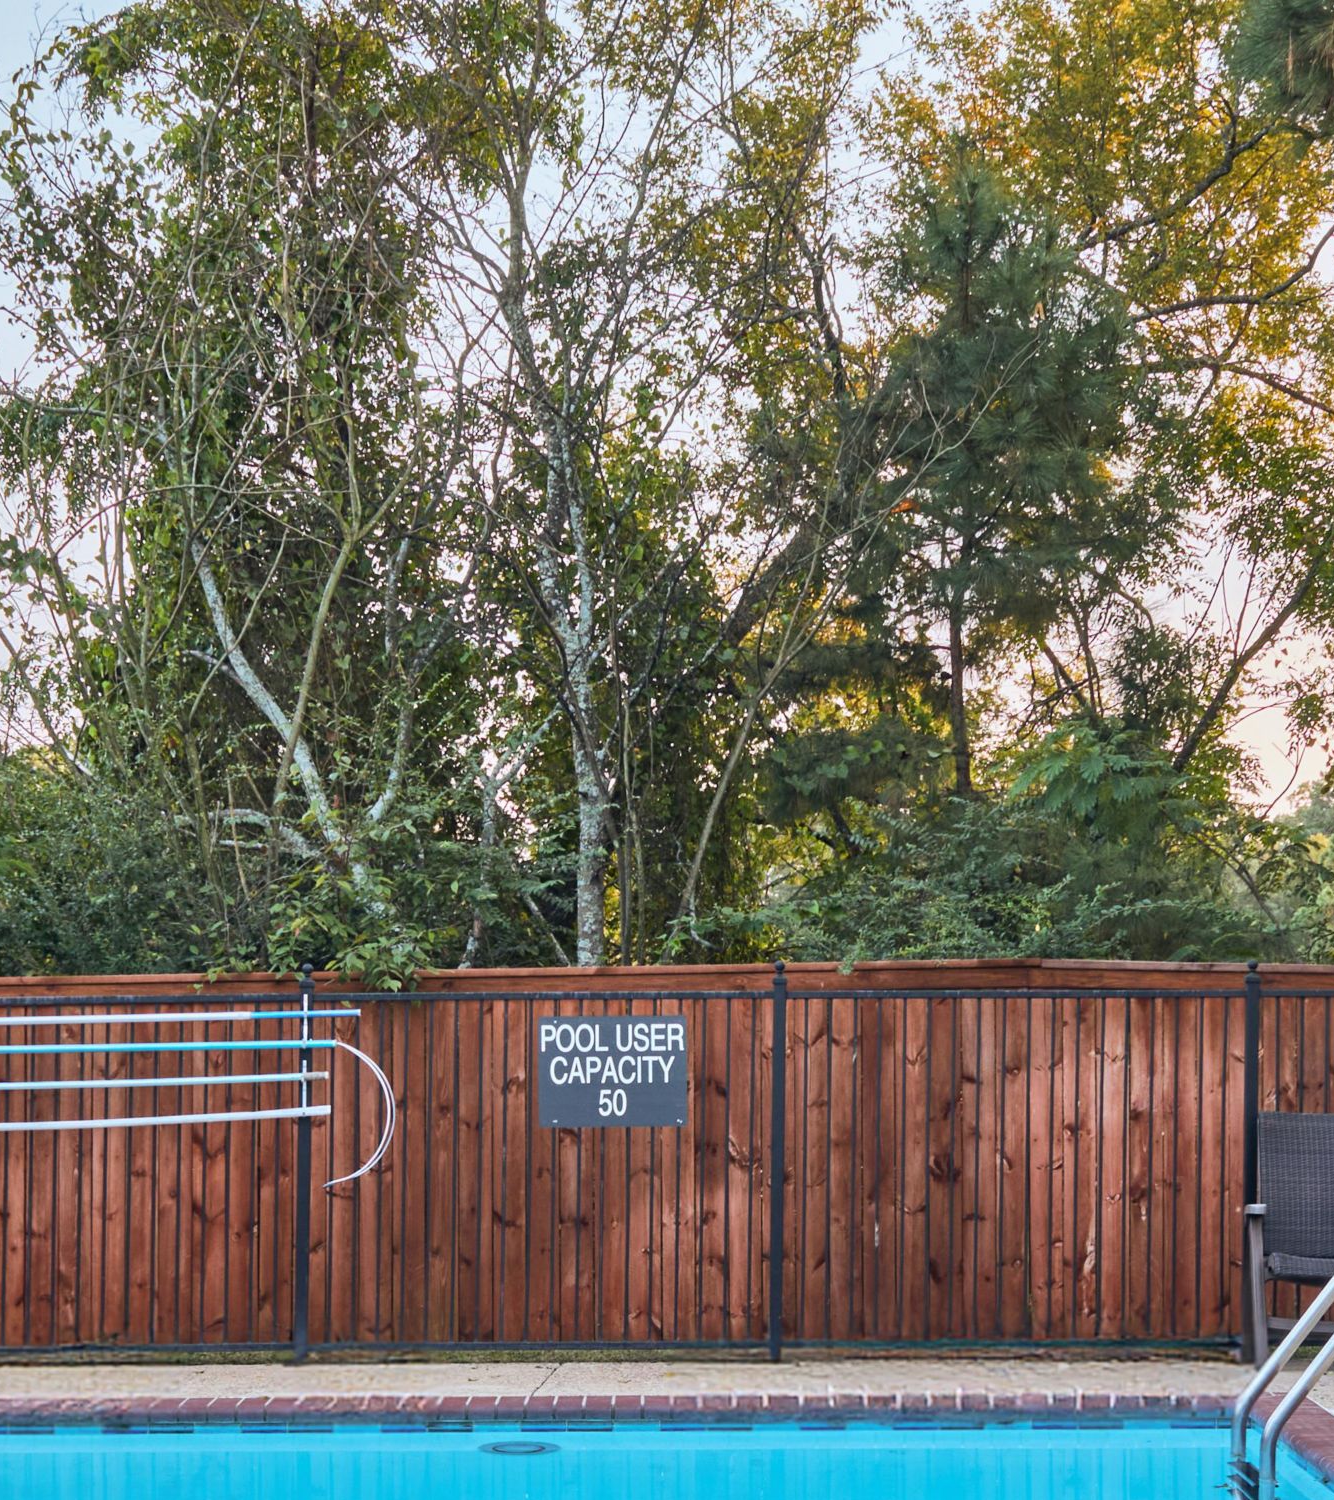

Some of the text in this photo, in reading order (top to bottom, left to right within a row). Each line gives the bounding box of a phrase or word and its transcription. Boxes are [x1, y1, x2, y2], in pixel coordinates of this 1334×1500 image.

[541, 1023, 684, 1052] POOL USER
[550, 1055, 675, 1085] CAPACITY
[598, 1088, 627, 1117] 50
